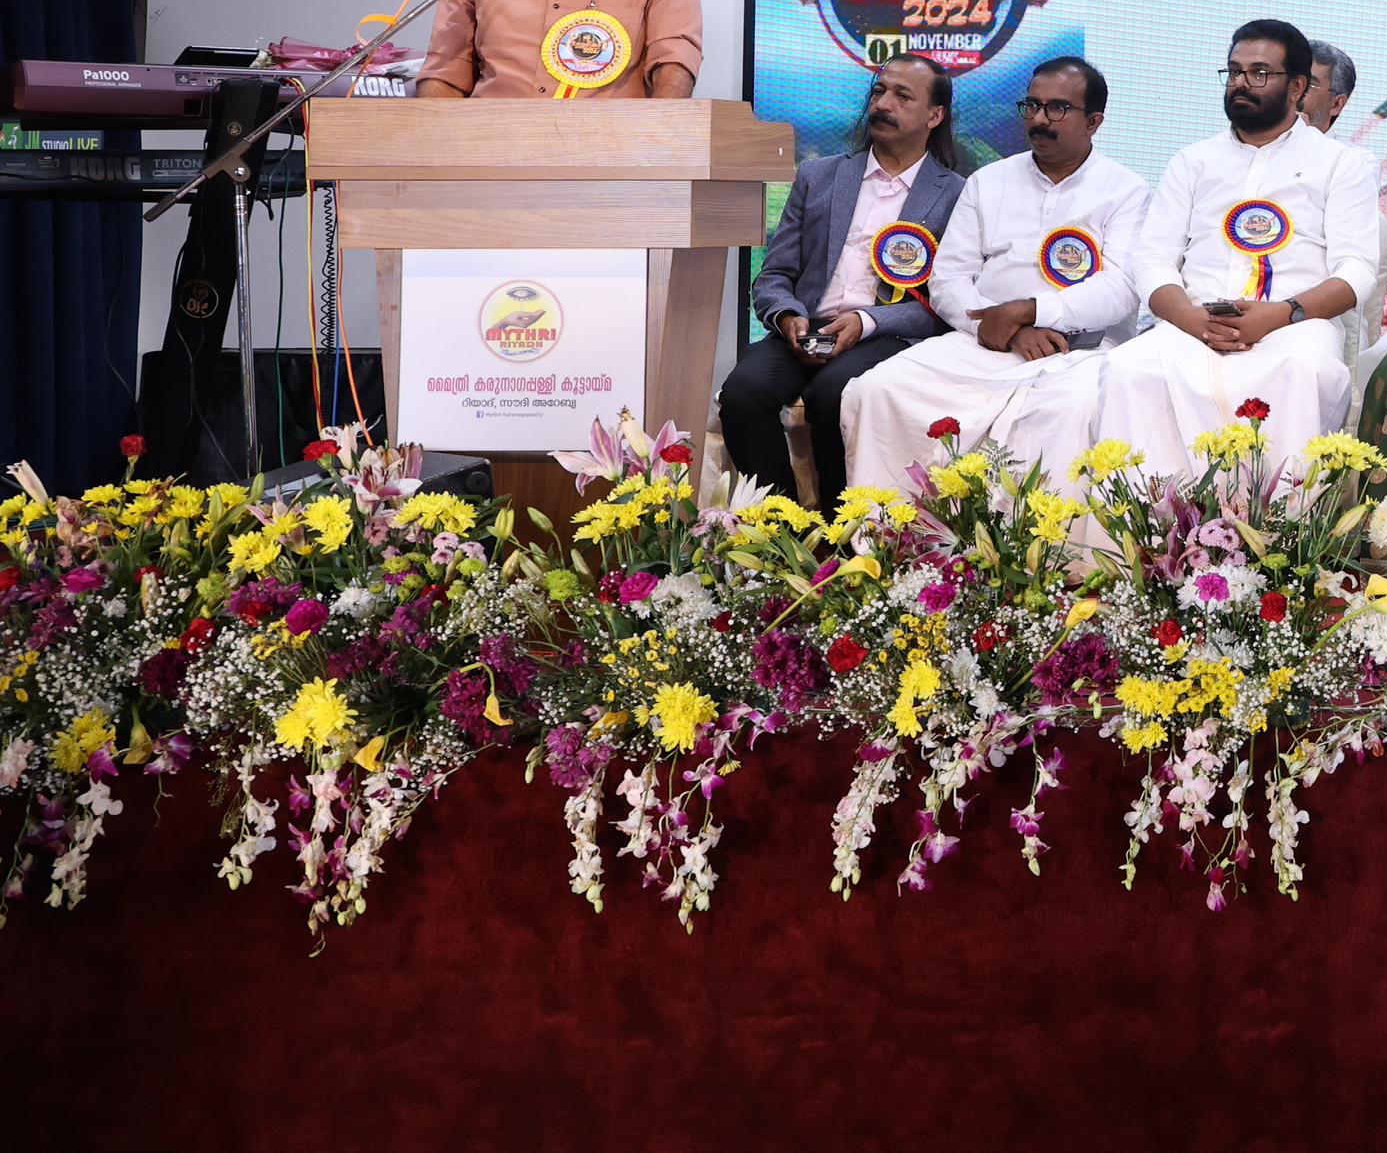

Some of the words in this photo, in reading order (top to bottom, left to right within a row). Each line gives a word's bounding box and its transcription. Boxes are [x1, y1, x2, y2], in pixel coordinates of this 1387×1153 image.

[908, 34, 982, 50] NOVEMBER
[83, 69, 130, 81] Pa1000
[351, 76, 406, 97] KORG
[71, 157, 141, 180] KORG
[153, 158, 202, 169] TRITON
[486, 328, 556, 341] MYTHRI
[427, 374, 469, 395] മൈത്രി
